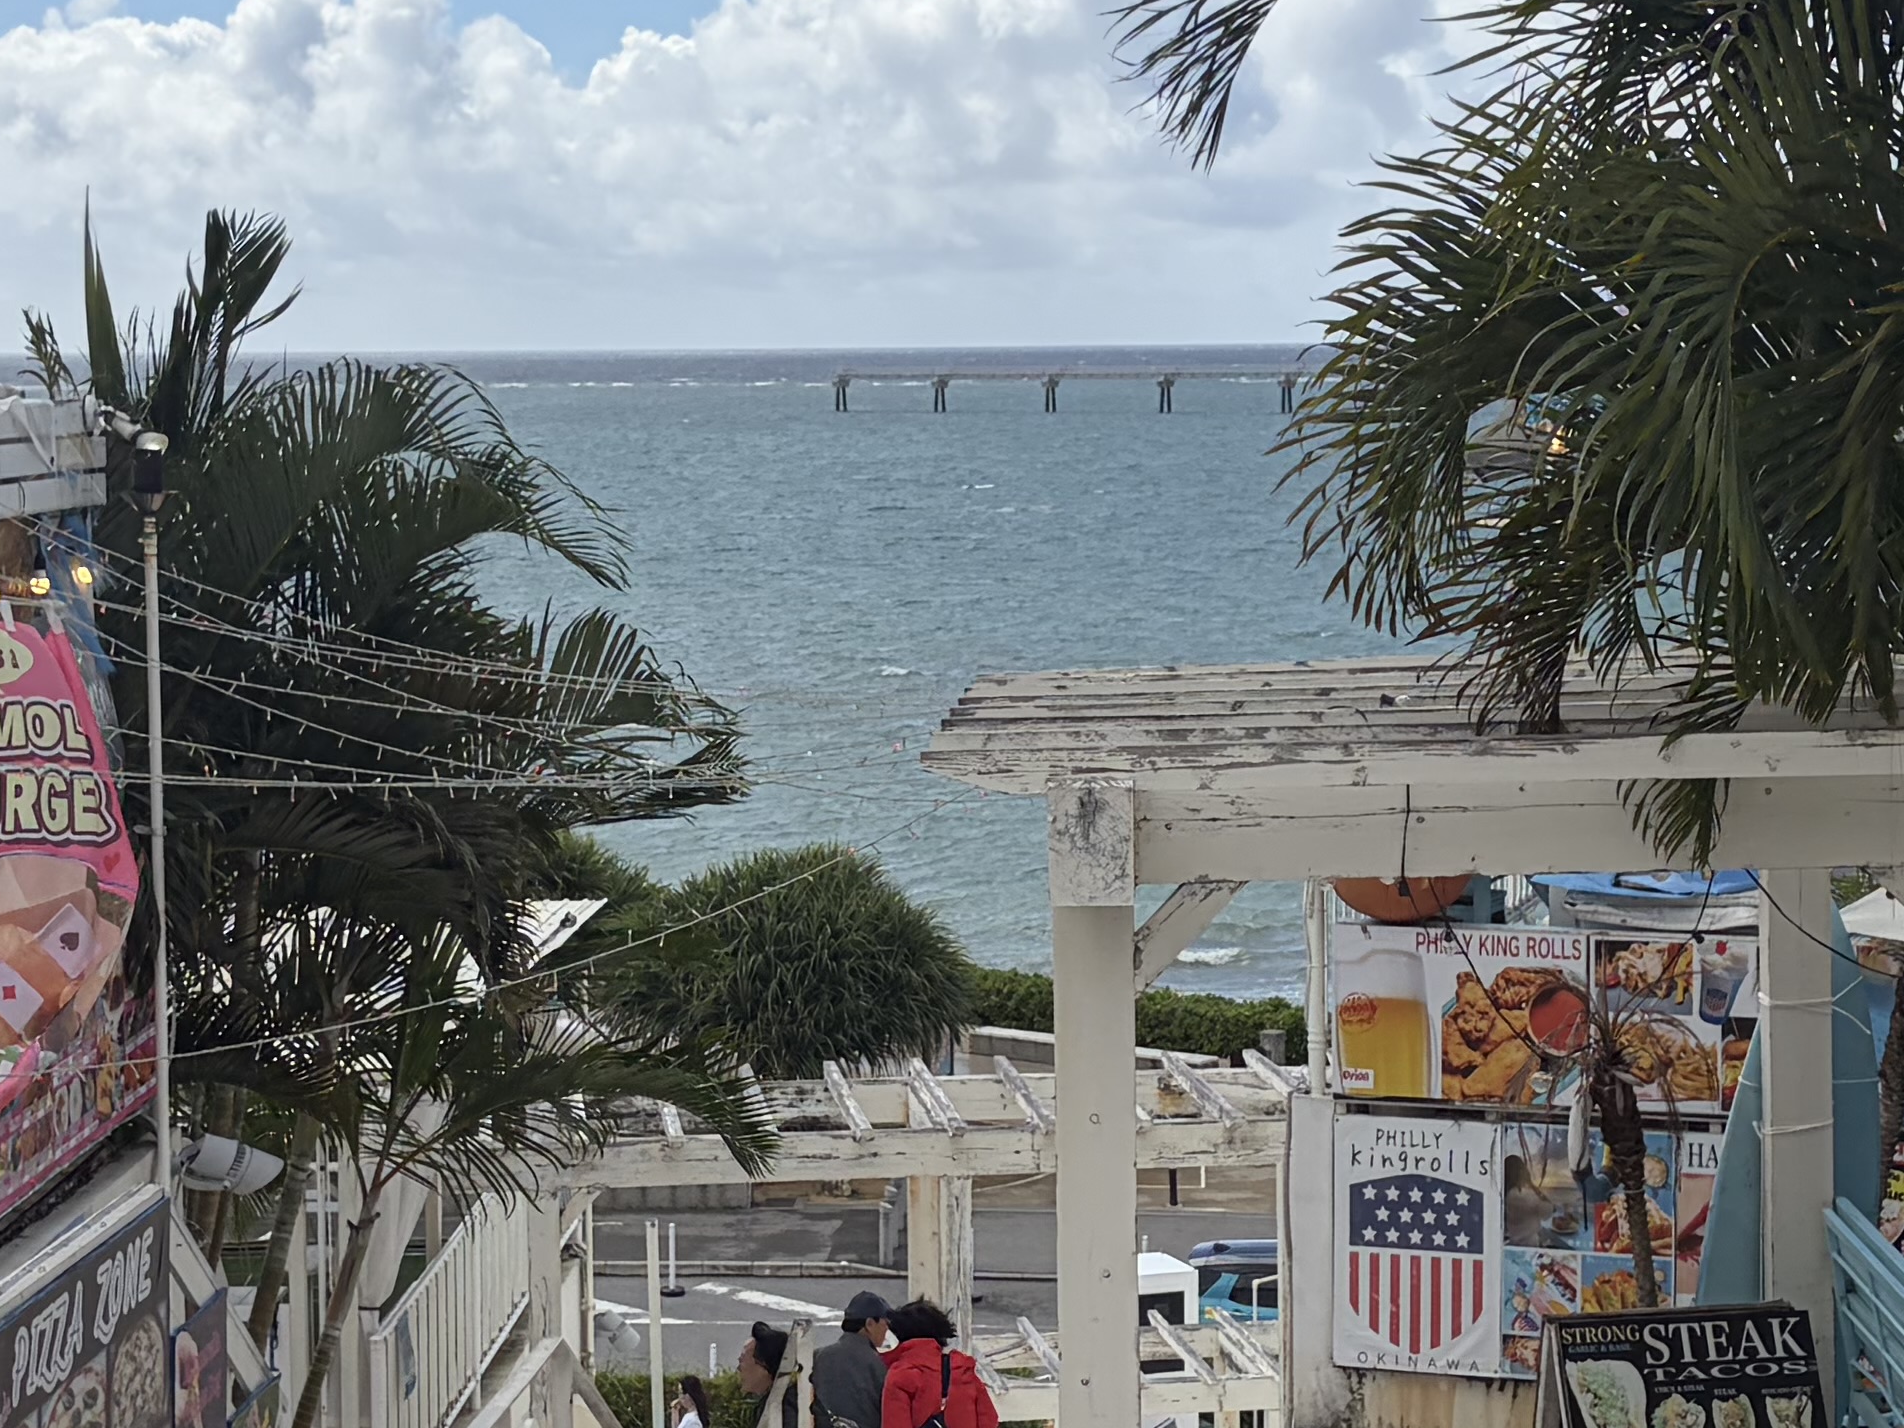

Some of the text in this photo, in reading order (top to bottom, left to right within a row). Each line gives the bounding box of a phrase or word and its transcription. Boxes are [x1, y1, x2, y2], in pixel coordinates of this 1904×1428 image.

[1479, 935, 1520, 958] KING
[1526, 938, 1583, 961] ROLLS
[1375, 1128, 1444, 1150] PHILLY
[1351, 1143, 1490, 1176] kingrolls
[12, 1280, 84, 1409] PIZZA
[93, 1226, 154, 1345] ZONE
[1561, 1323, 1641, 1345] STRONG
[1642, 1316, 1808, 1365] STEAK
[1357, 1350, 1480, 1373] OKINAWA
[1643, 1359, 1809, 1382] TACOS
